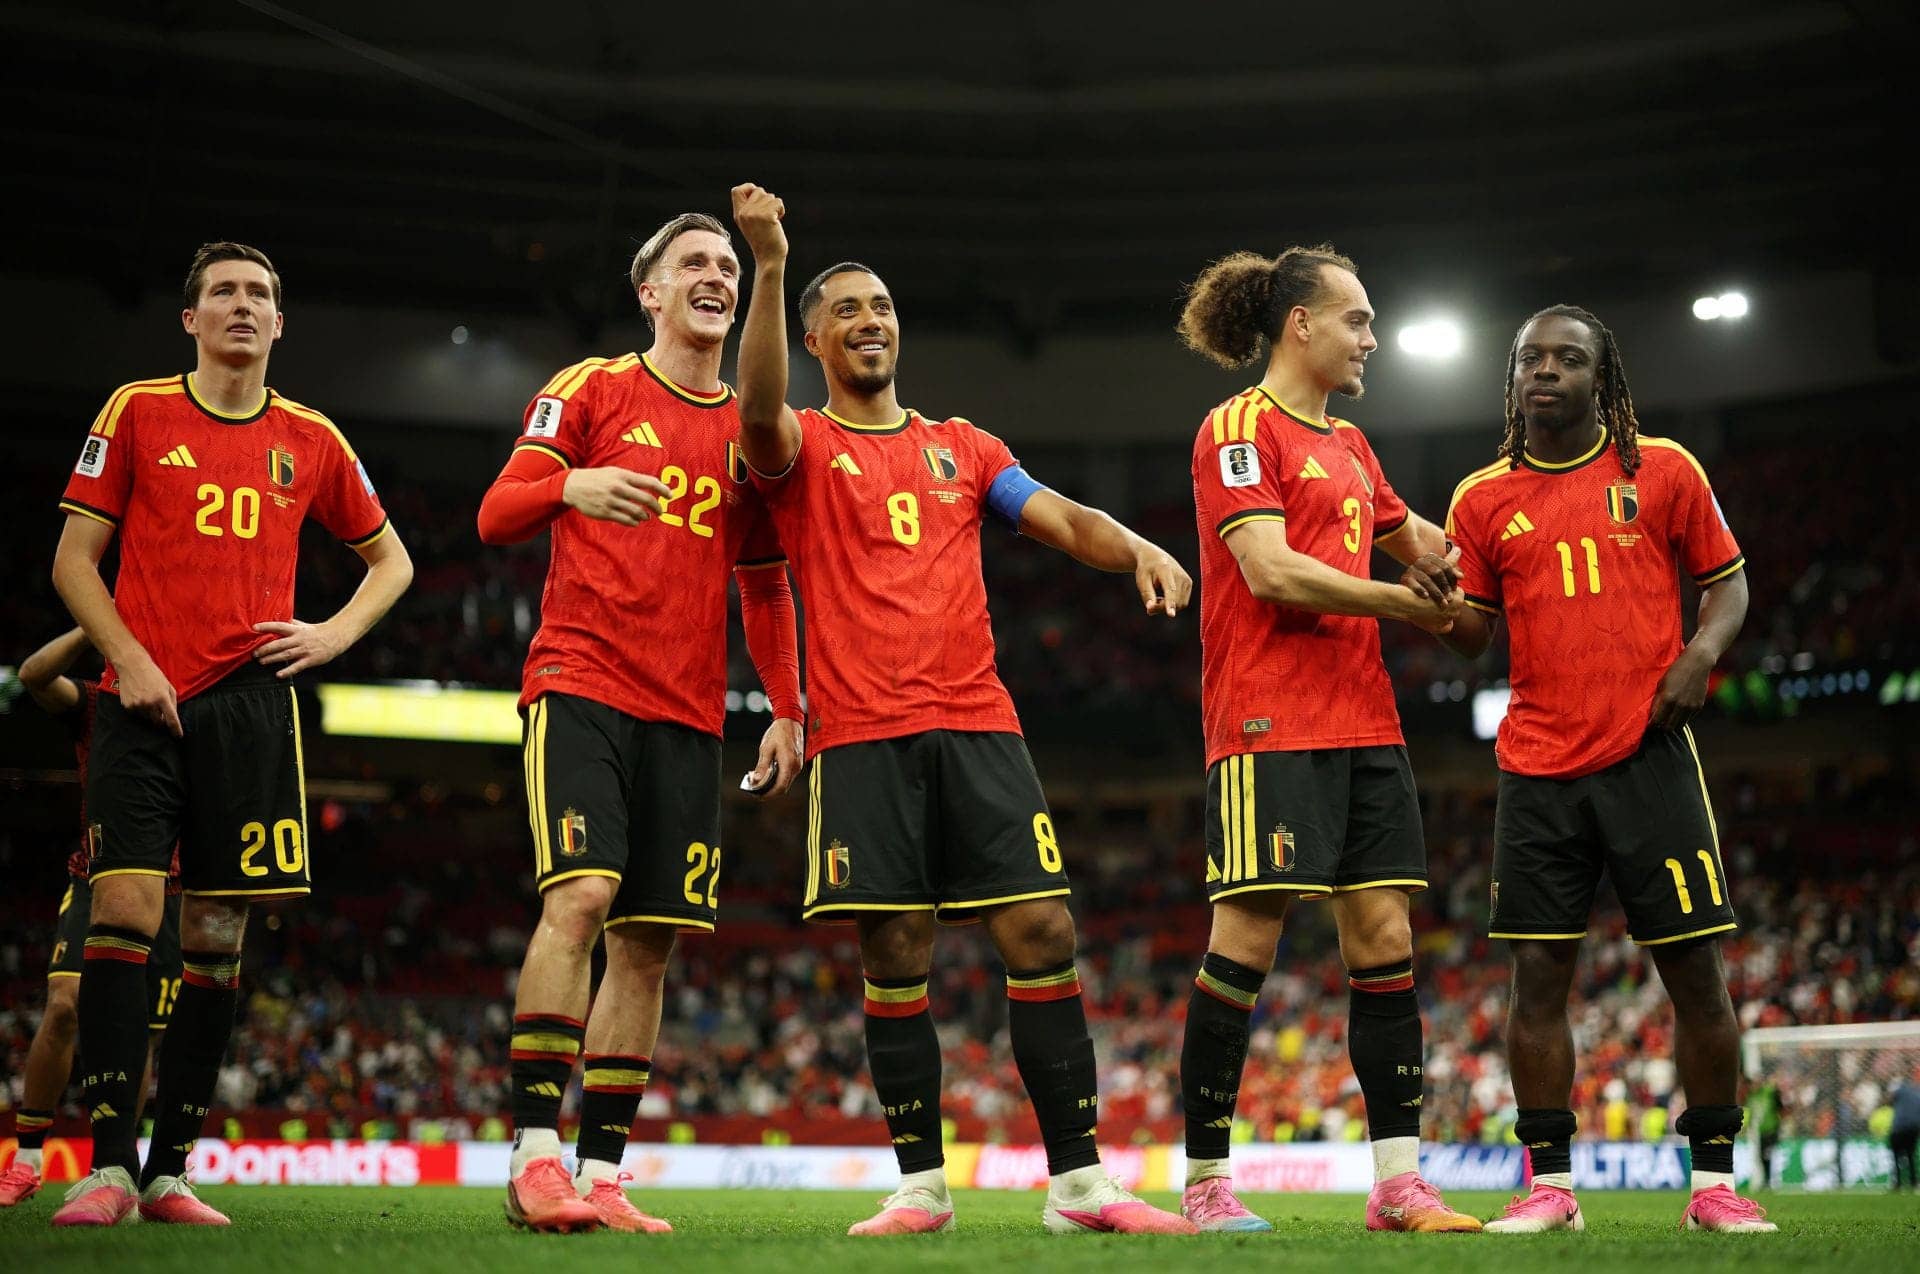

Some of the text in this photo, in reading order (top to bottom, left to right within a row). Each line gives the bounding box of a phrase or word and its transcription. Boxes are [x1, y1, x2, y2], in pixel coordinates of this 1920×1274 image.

[196, 483, 260, 539] 20
[657, 465, 721, 538] 22
[886, 491, 920, 546] 8
[1343, 497, 1361, 554] 3
[1556, 537, 1601, 597] 11
[240, 818, 303, 877] 20
[1033, 812, 1062, 873] 8
[683, 842, 721, 909] 22
[1665, 849, 1722, 914] 11
